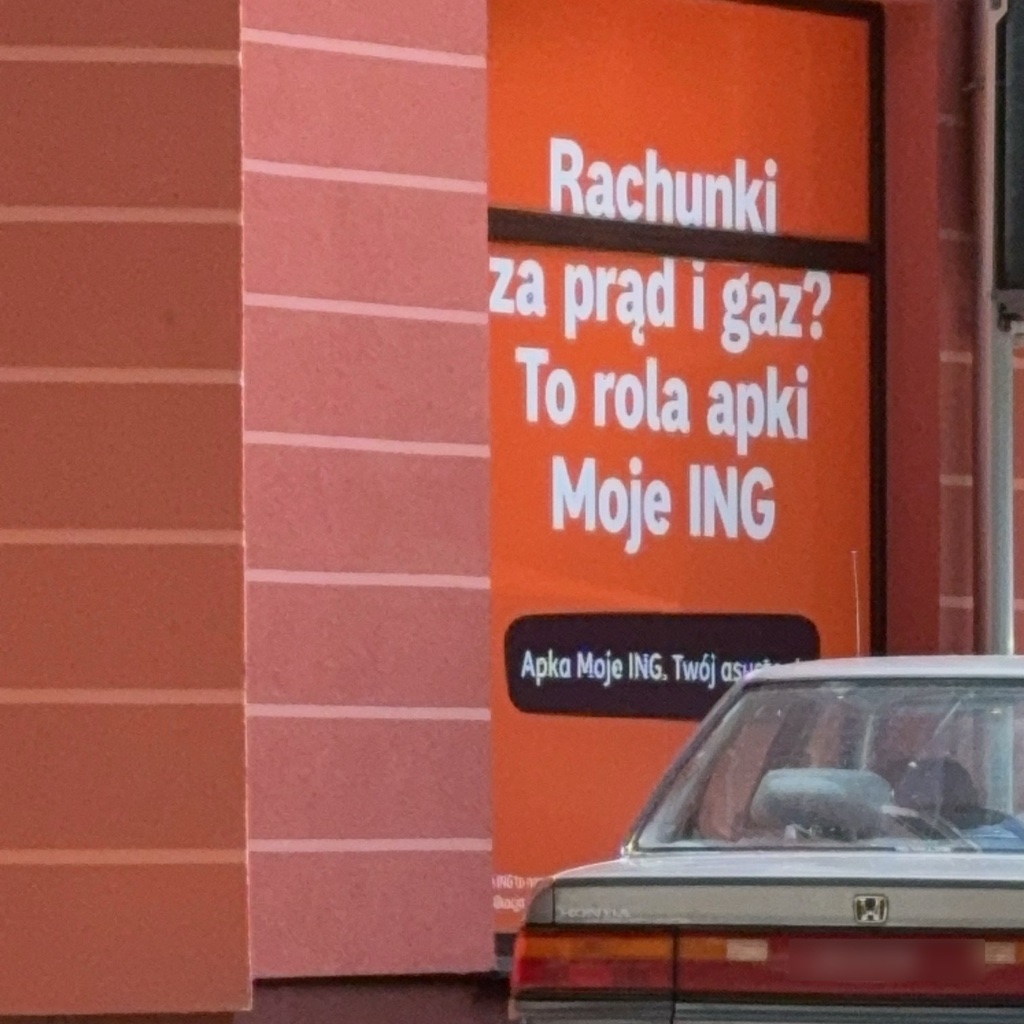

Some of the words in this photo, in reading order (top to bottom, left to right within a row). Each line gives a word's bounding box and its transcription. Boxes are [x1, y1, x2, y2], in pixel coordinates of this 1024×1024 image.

[549, 136, 778, 234] Rachunki
[489, 256, 547, 317] za
[564, 257, 676, 346] prąd
[692, 261, 706, 330] i
[721, 271, 832, 354] gaz?
[515, 346, 576, 425] To
[593, 356, 691, 434] rola
[706, 364, 810, 456] apki
[552, 455, 672, 554] Moje
[689, 464, 776, 541] ING
[521, 650, 571, 686] Apka
[577, 650, 623, 687] Moje
[628, 653, 668, 682] ING.
[672, 653, 717, 689] Twój
